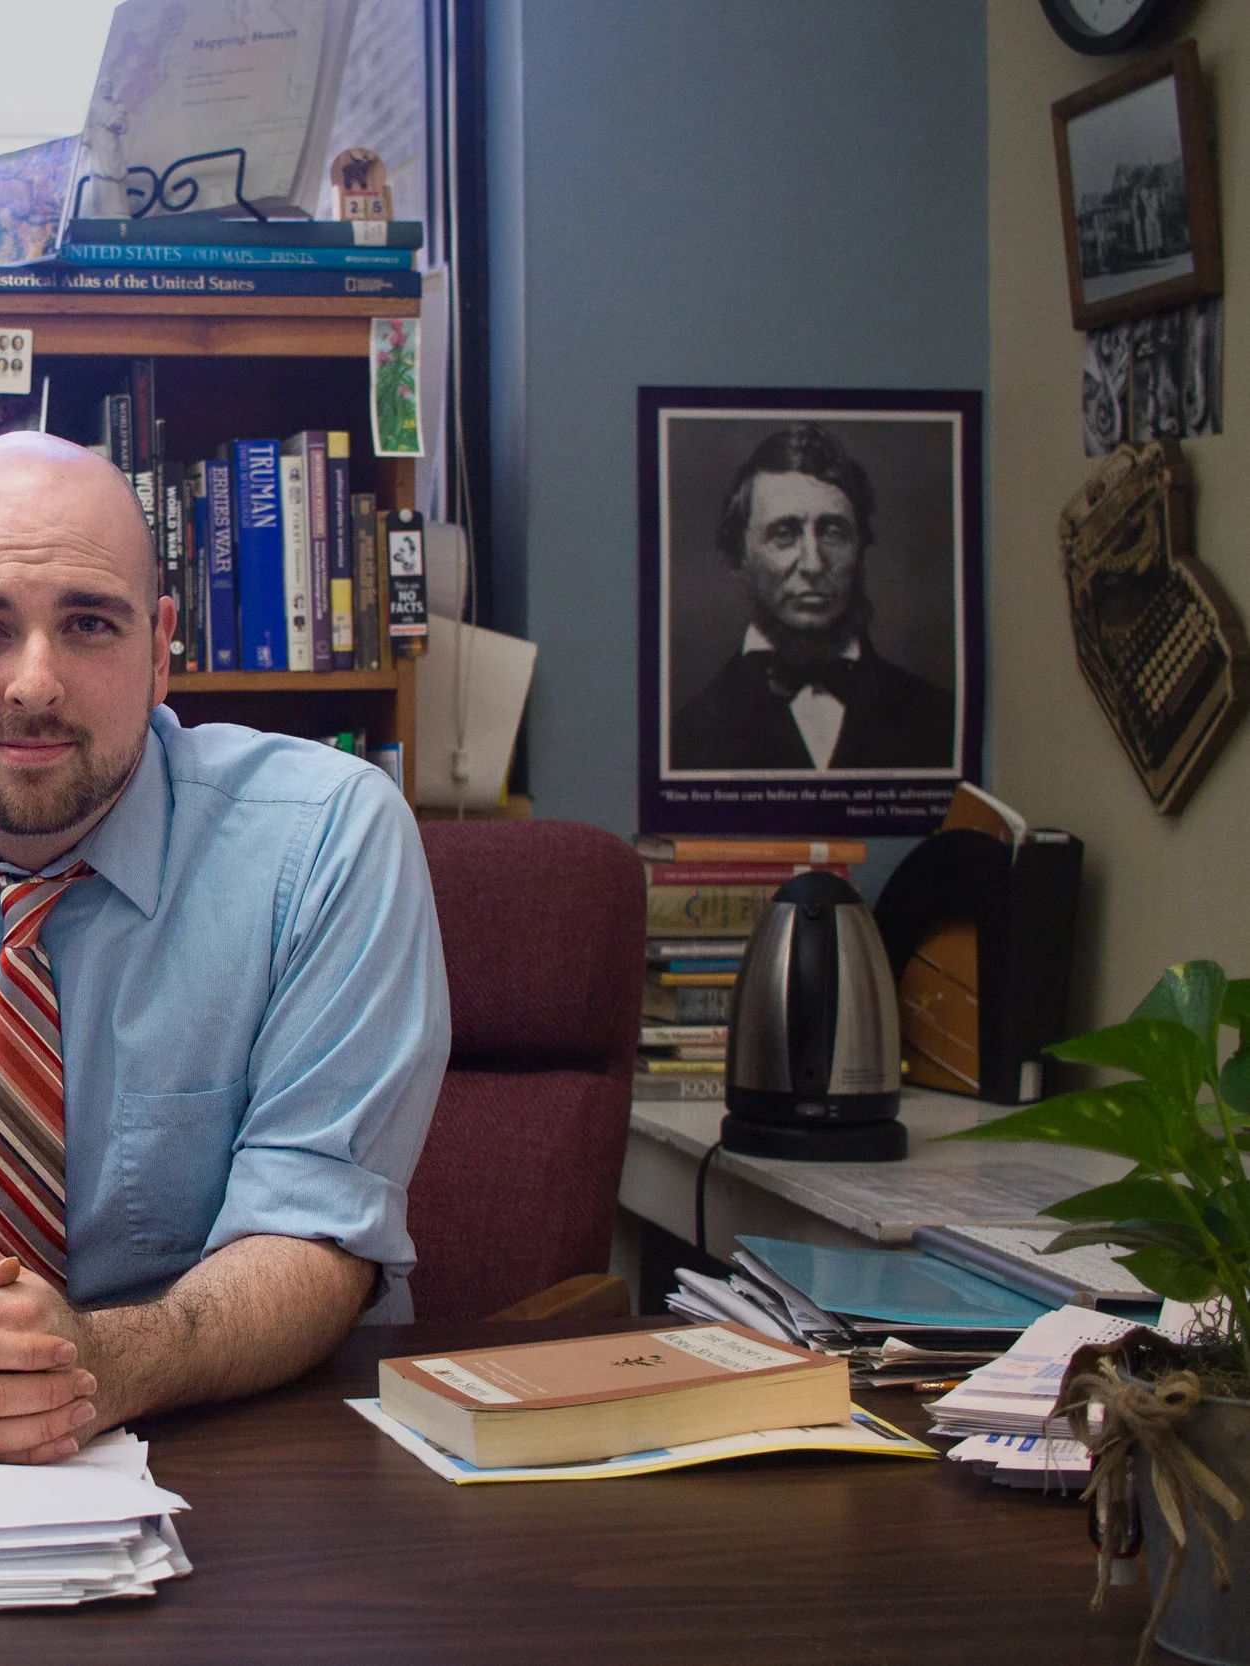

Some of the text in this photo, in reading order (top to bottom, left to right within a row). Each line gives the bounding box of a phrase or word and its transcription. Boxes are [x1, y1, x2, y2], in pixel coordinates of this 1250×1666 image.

[349, 201, 358, 213] 2
[63, 243, 121, 260] UNITED
[125, 245, 182, 261] STATES
[192, 250, 219, 262] OLD
[222, 250, 254, 263] MAPS
[63, 274, 100, 290] Atlas
[104, 274, 120, 290] of
[123, 275, 147, 290] the
[152, 275, 204, 291] United
[208, 277, 255, 292] States
[118, 402, 130, 460] WORLD WAR
[249, 444, 277, 528] TRUMAN
[166, 486, 178, 570] WORLD WAR II
[215, 527, 231, 573] WAR
[398, 590, 417, 602] NO
[390, 602, 424, 614] FACTS
[713, 789, 739, 801] from
[741, 791, 764, 801] care
[766, 788, 798, 801] before
[801, 788, 817, 800] the
[853, 788, 872, 800] and
[875, 788, 896, 800] seek
